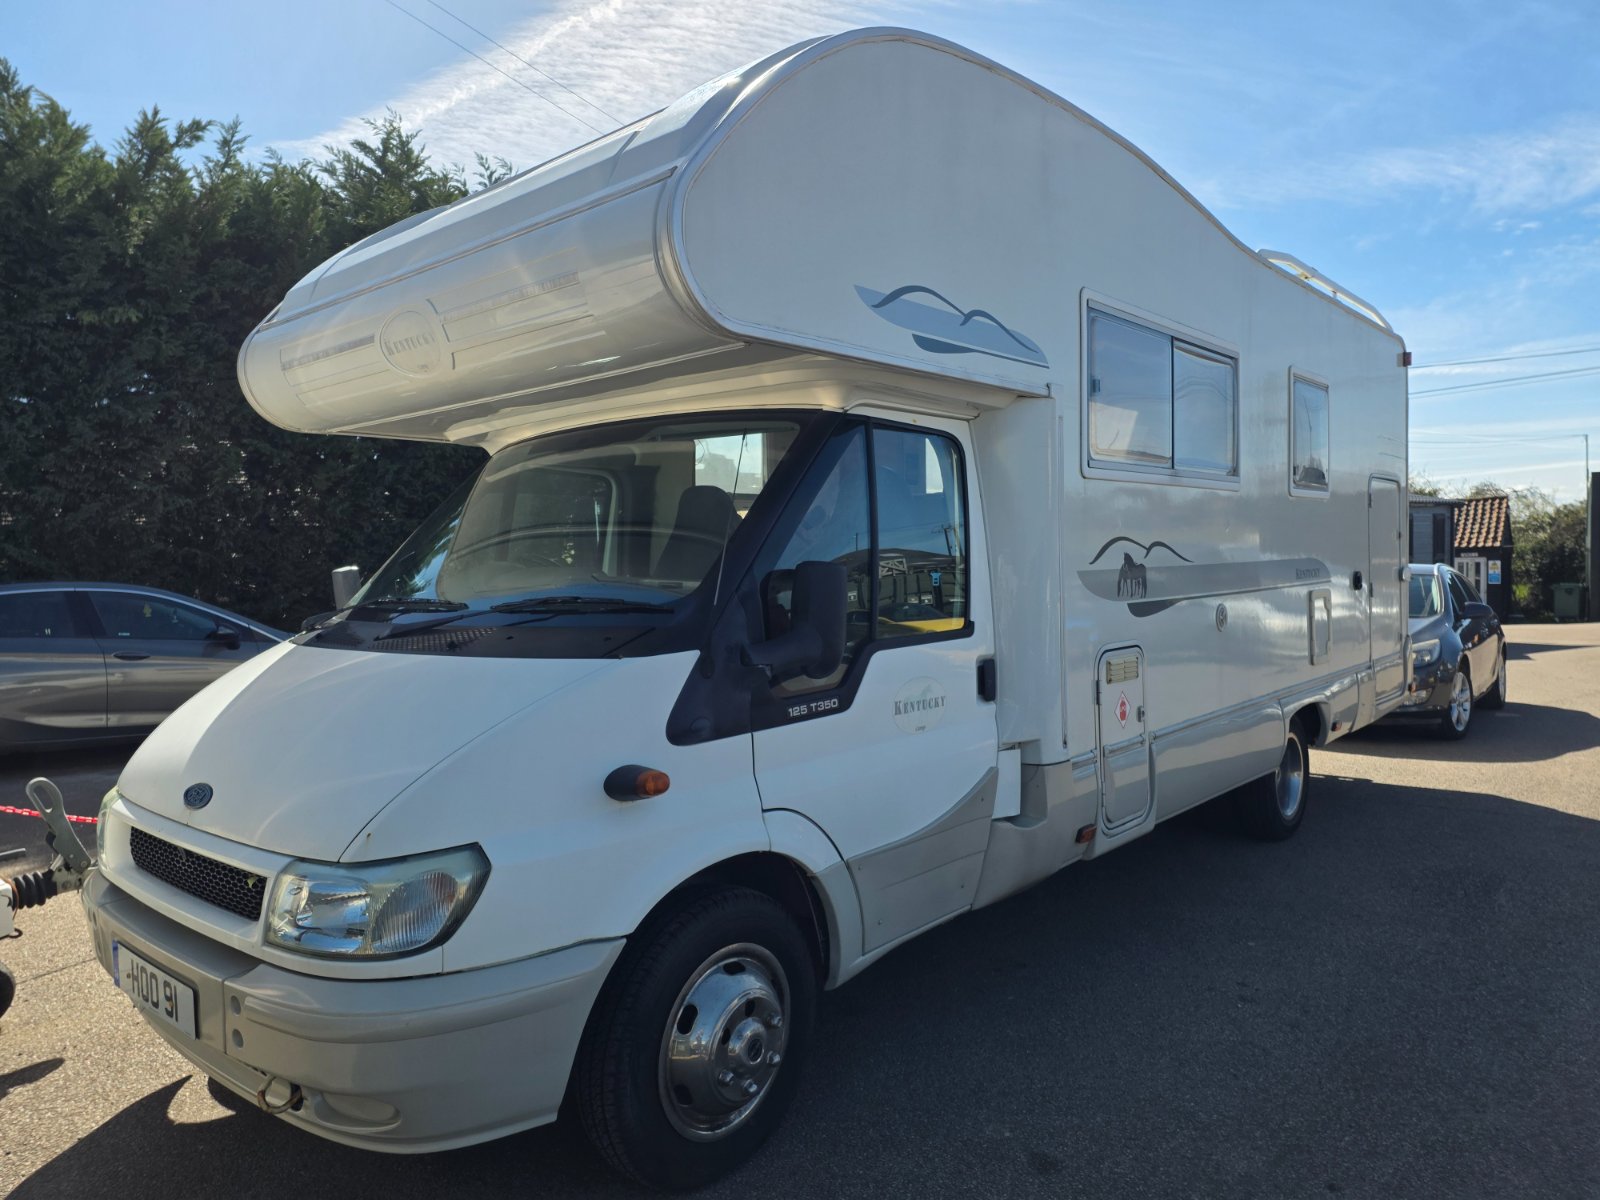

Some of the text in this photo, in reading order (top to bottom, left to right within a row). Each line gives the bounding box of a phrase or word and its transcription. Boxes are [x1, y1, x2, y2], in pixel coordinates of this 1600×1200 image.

[788, 699, 839, 717] 125 T350
[894, 695, 946, 716] KENTUCKY
[163, 980, 179, 1023] 91
